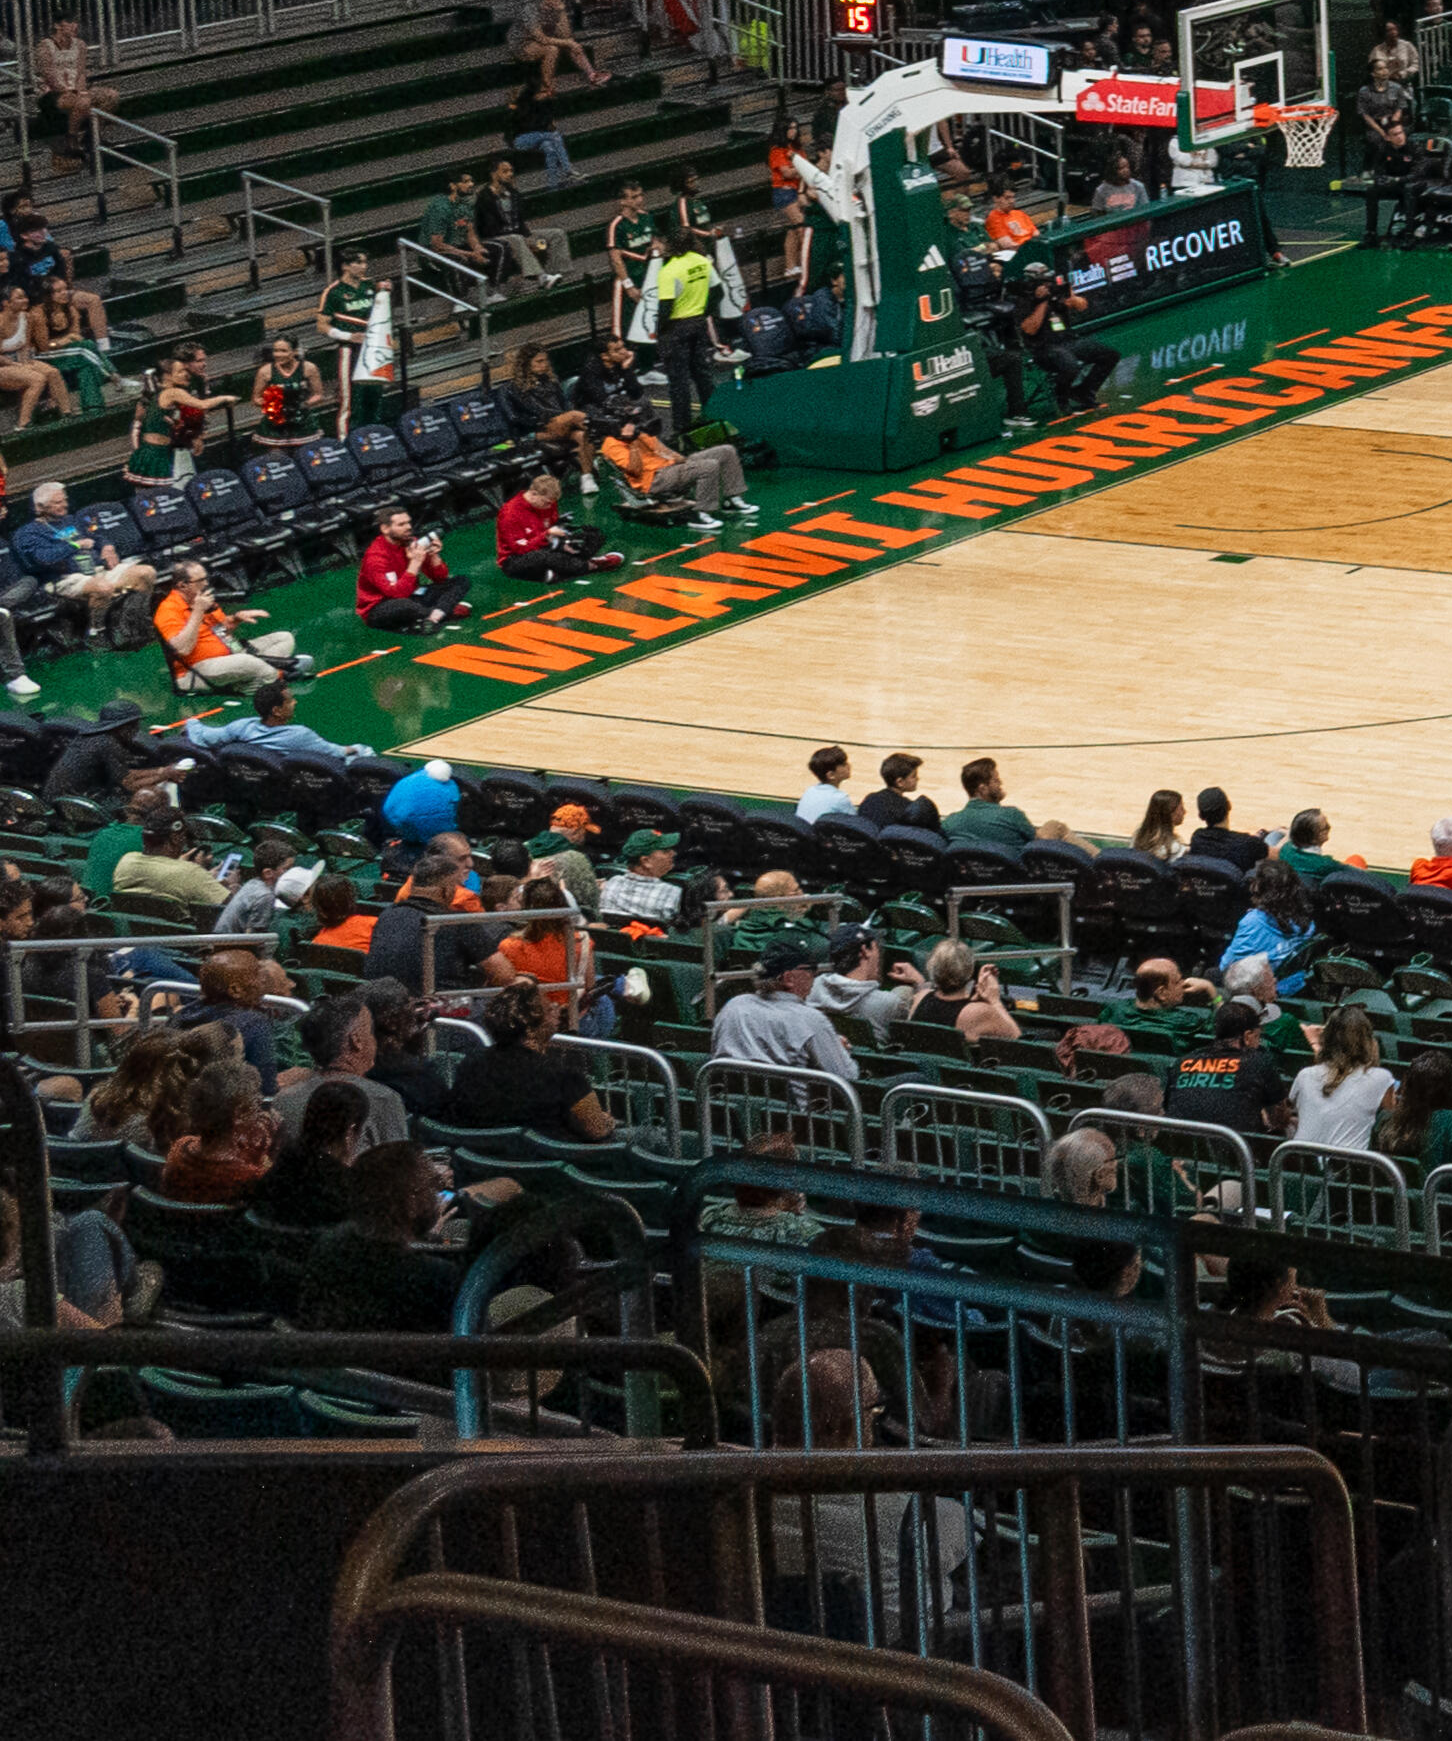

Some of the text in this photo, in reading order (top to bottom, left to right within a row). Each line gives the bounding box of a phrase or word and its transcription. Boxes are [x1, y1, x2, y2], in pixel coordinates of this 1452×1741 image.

[847, 7, 872, 32] 15
[961, 45, 1033, 70] UHealth
[1146, 220, 1245, 272] RECOVER
[912, 346, 973, 382] UHealth
[413, 511, 943, 686] MIAMI
[1180, 1058, 1241, 1073] CANES
[1176, 1073, 1236, 1089] GIRLS
